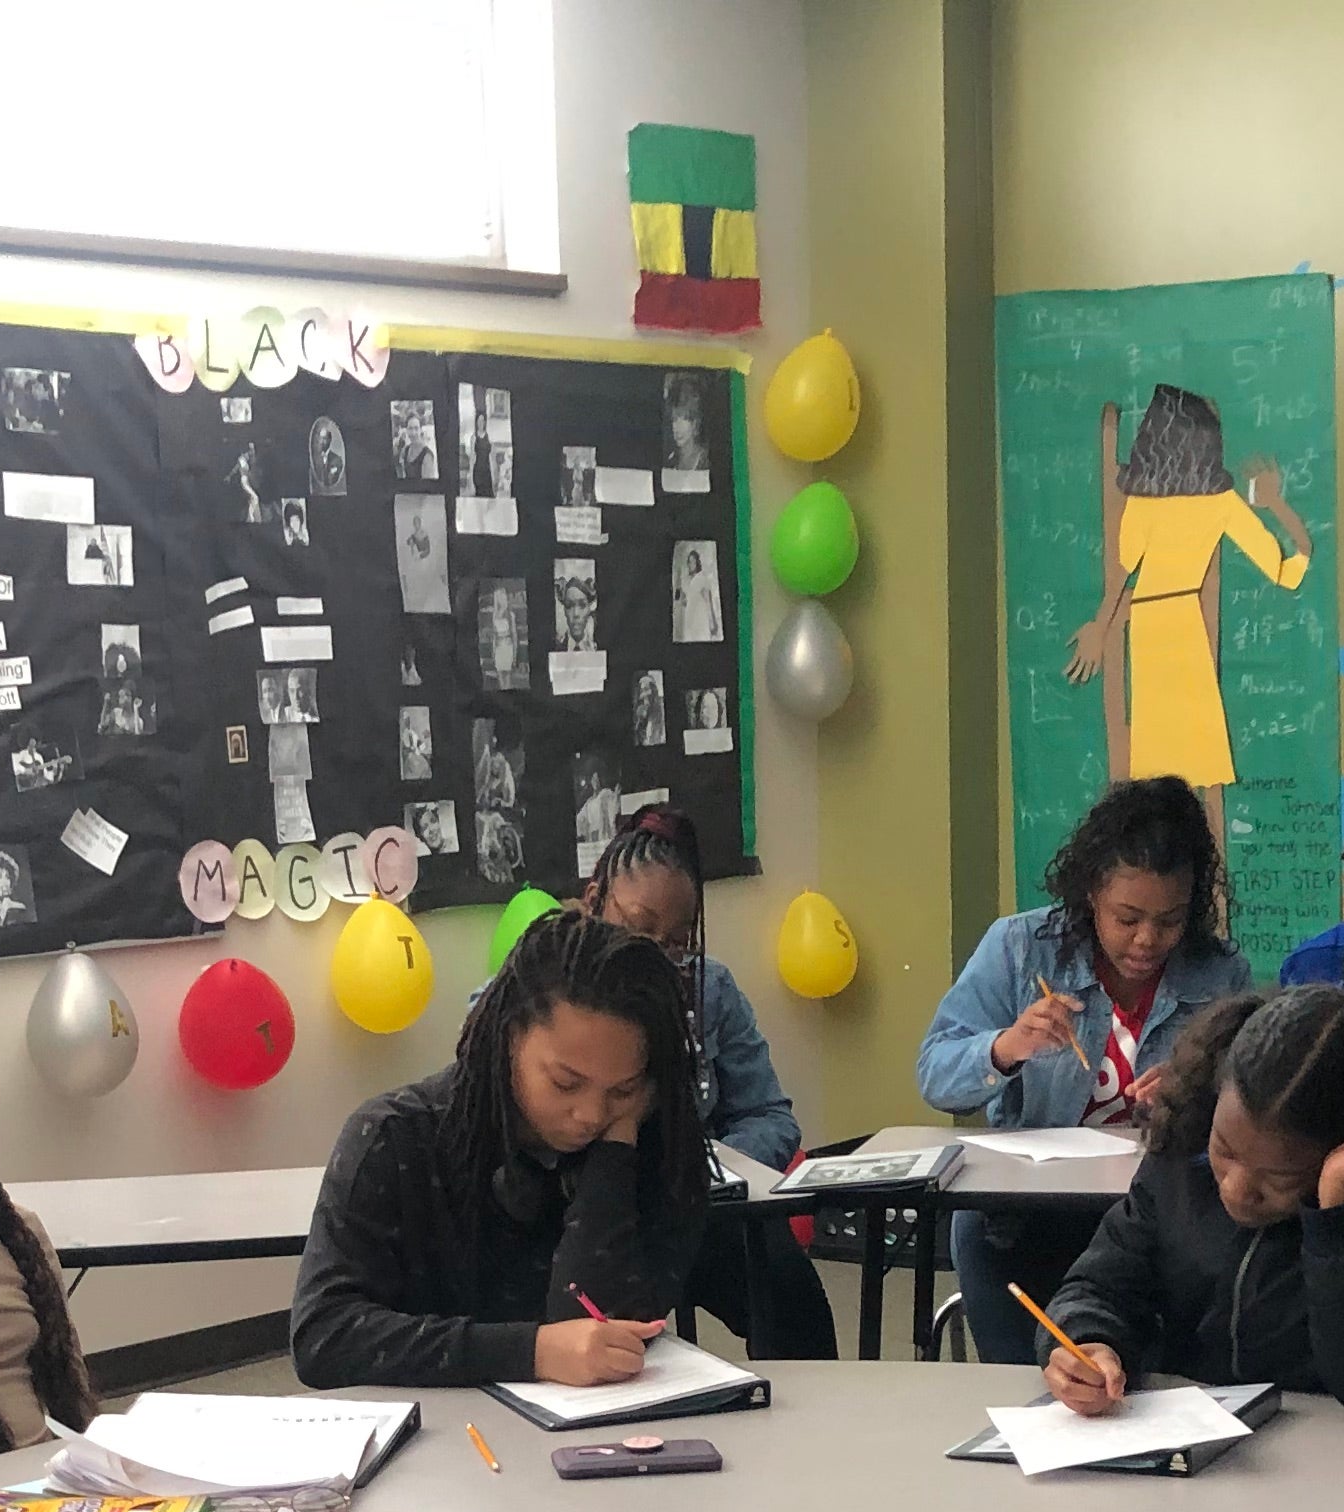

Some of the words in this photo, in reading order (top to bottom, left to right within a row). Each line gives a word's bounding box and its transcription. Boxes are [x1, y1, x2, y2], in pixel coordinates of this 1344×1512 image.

[158, 319, 374, 376] BLACK
[1292, 821, 1326, 834] once
[193, 838, 399, 910] MAGIC
[1234, 869, 1281, 892] FIRST
[1290, 868, 1336, 891] STEP
[833, 919, 850, 948] S
[397, 936, 414, 969] T
[108, 999, 130, 1038] A
